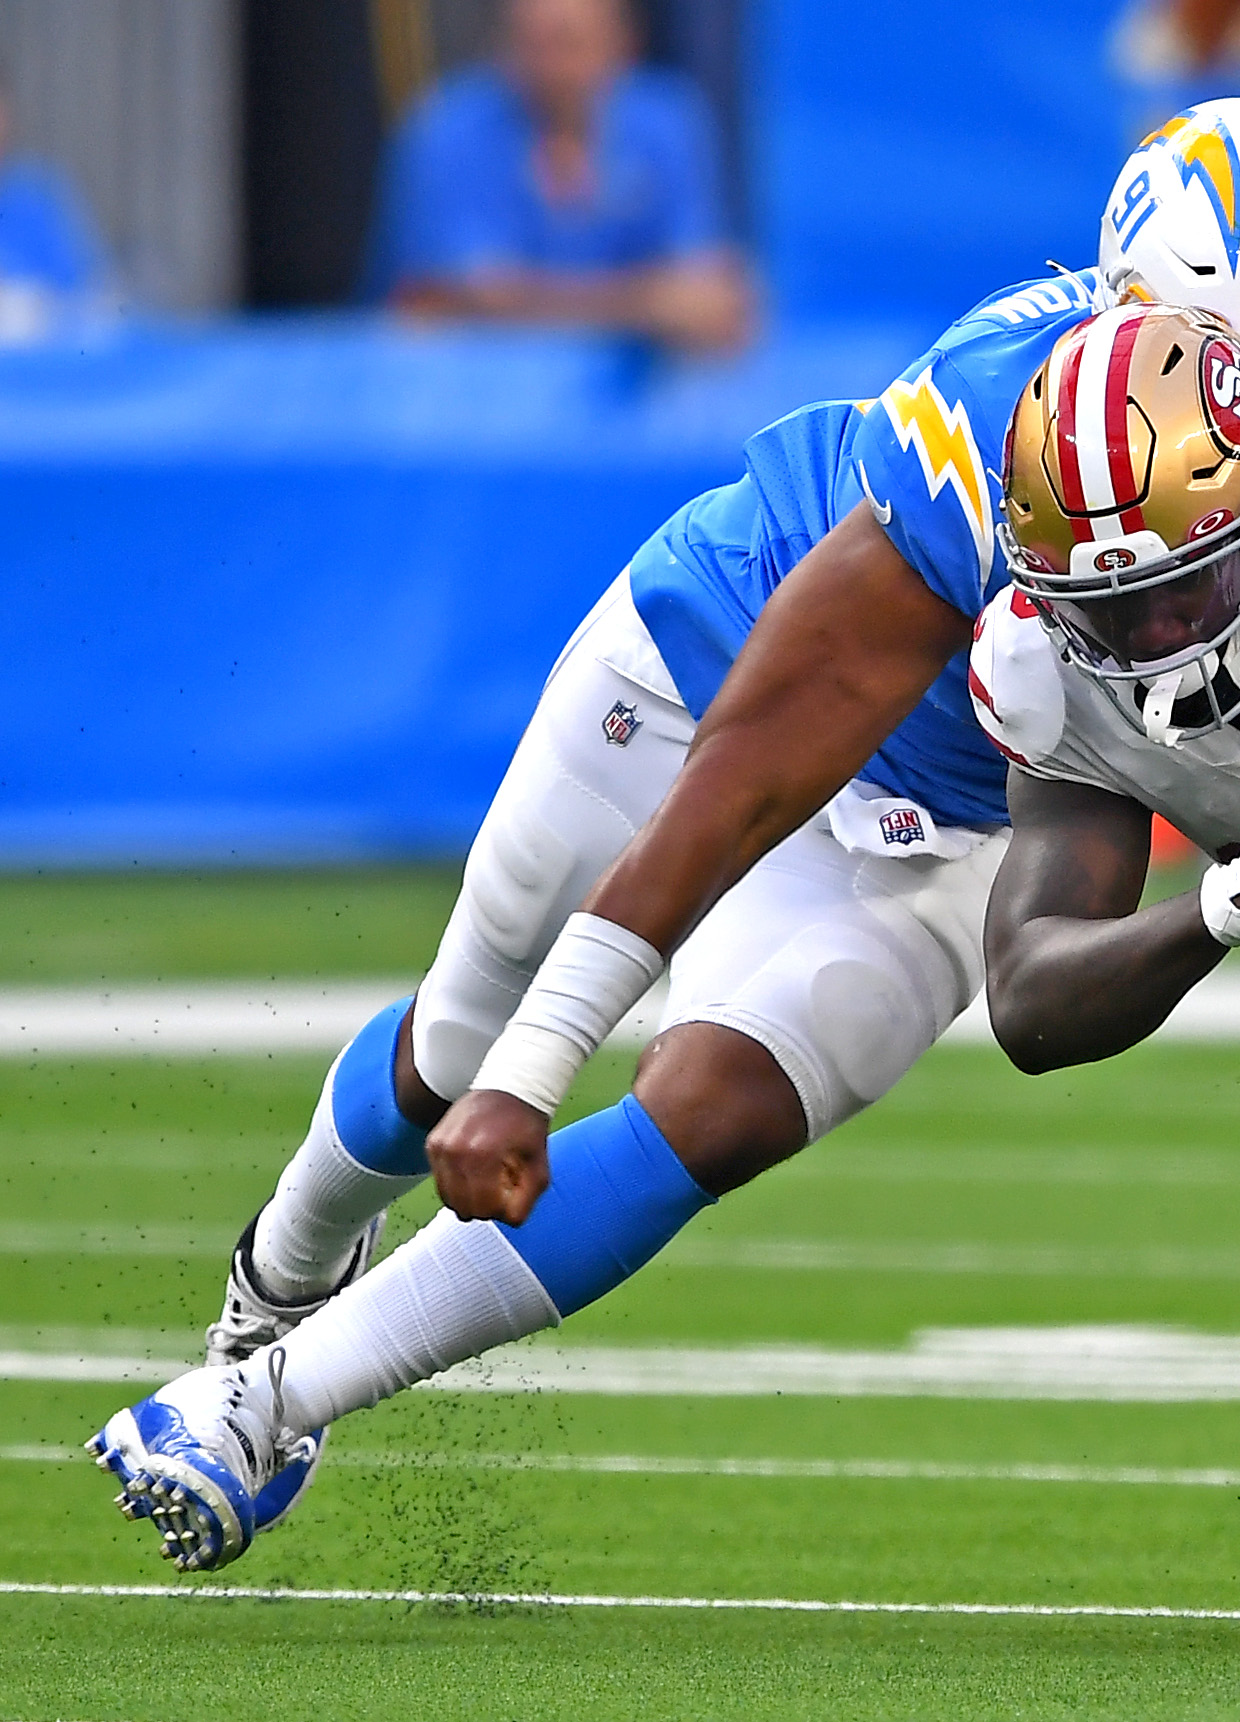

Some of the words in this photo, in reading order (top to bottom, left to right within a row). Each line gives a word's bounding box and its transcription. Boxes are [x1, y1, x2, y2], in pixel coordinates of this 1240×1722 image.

[1112, 170, 1158, 254] 91
[606, 714, 628, 741] NFL
[882, 811, 918, 830] NFL
